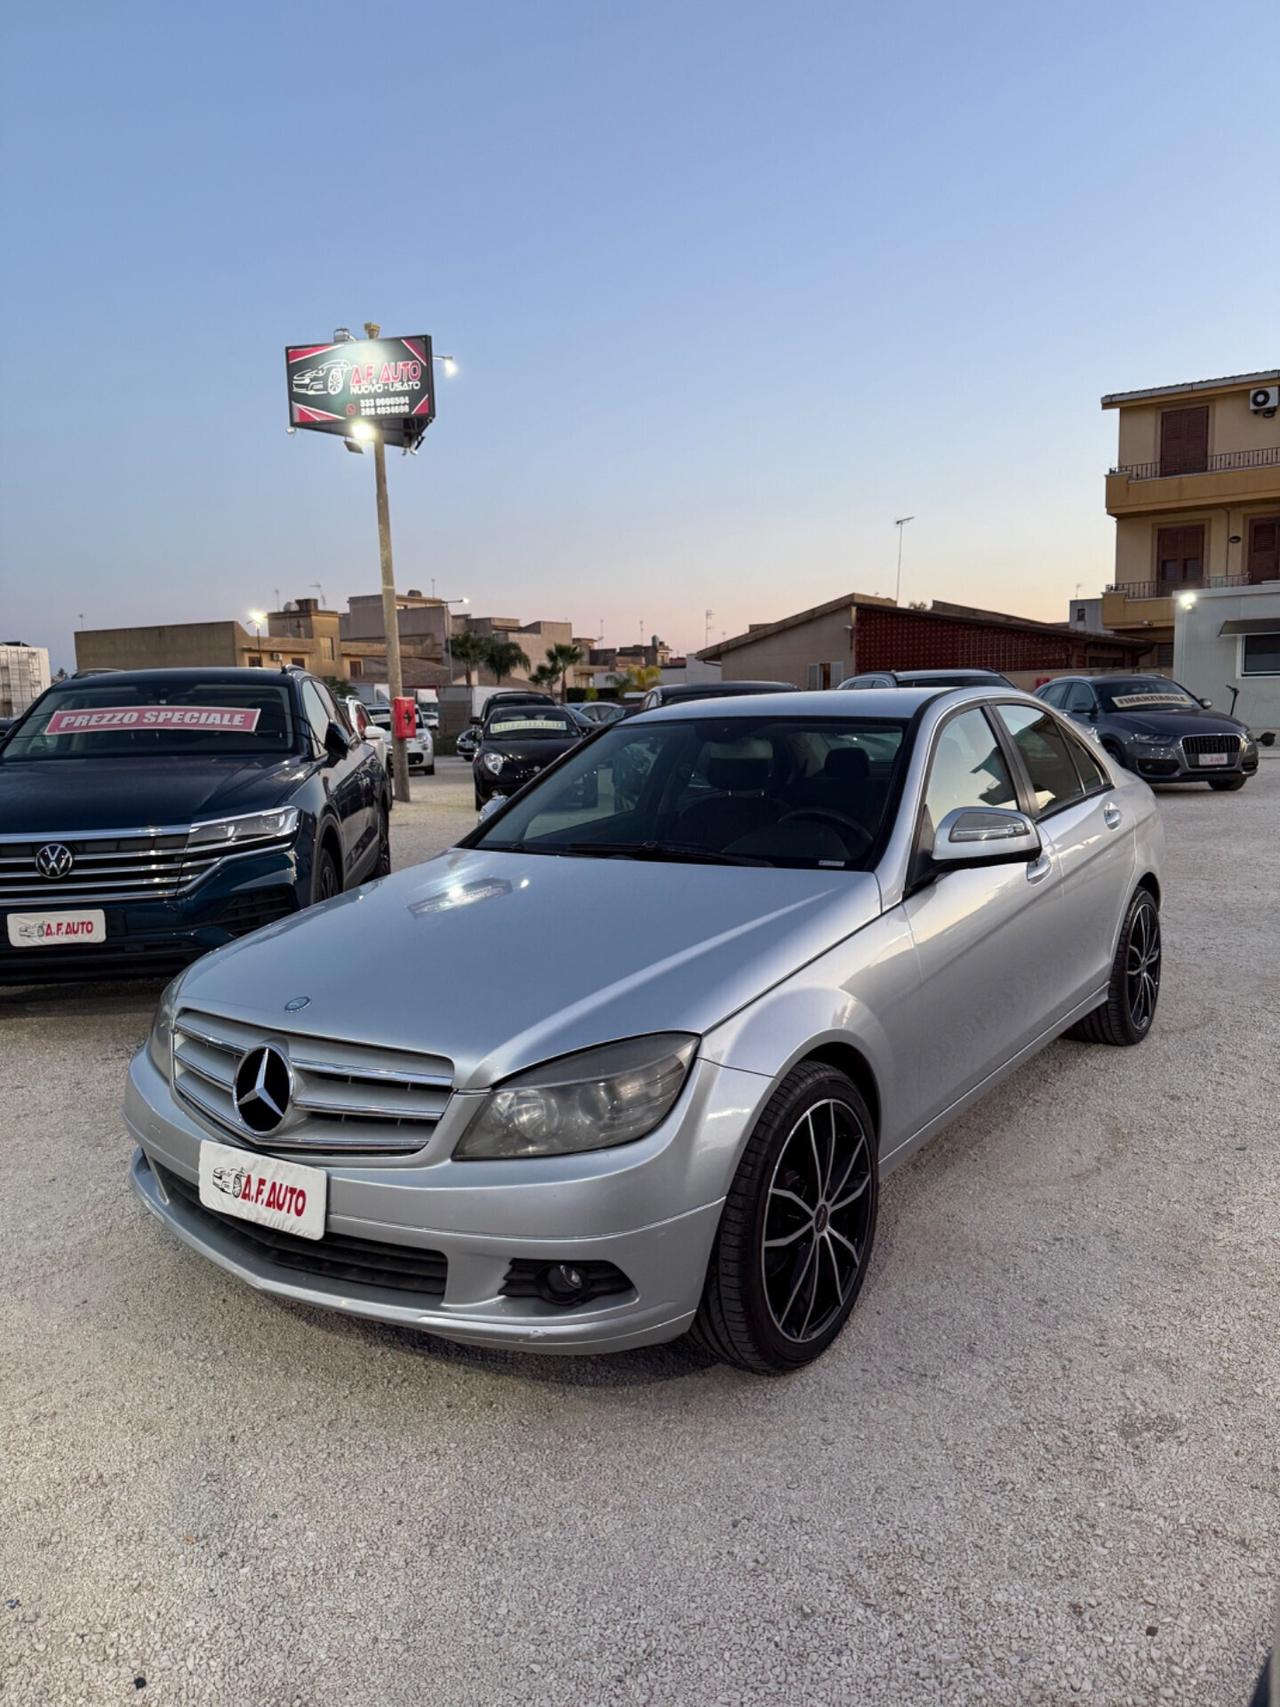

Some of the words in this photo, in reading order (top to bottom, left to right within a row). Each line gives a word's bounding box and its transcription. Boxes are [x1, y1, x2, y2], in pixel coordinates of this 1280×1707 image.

[379, 360, 422, 384] AUTO
[389, 381, 421, 392] USATO
[60, 711, 137, 728] PREZZO
[143, 711, 246, 726] SPECIALE
